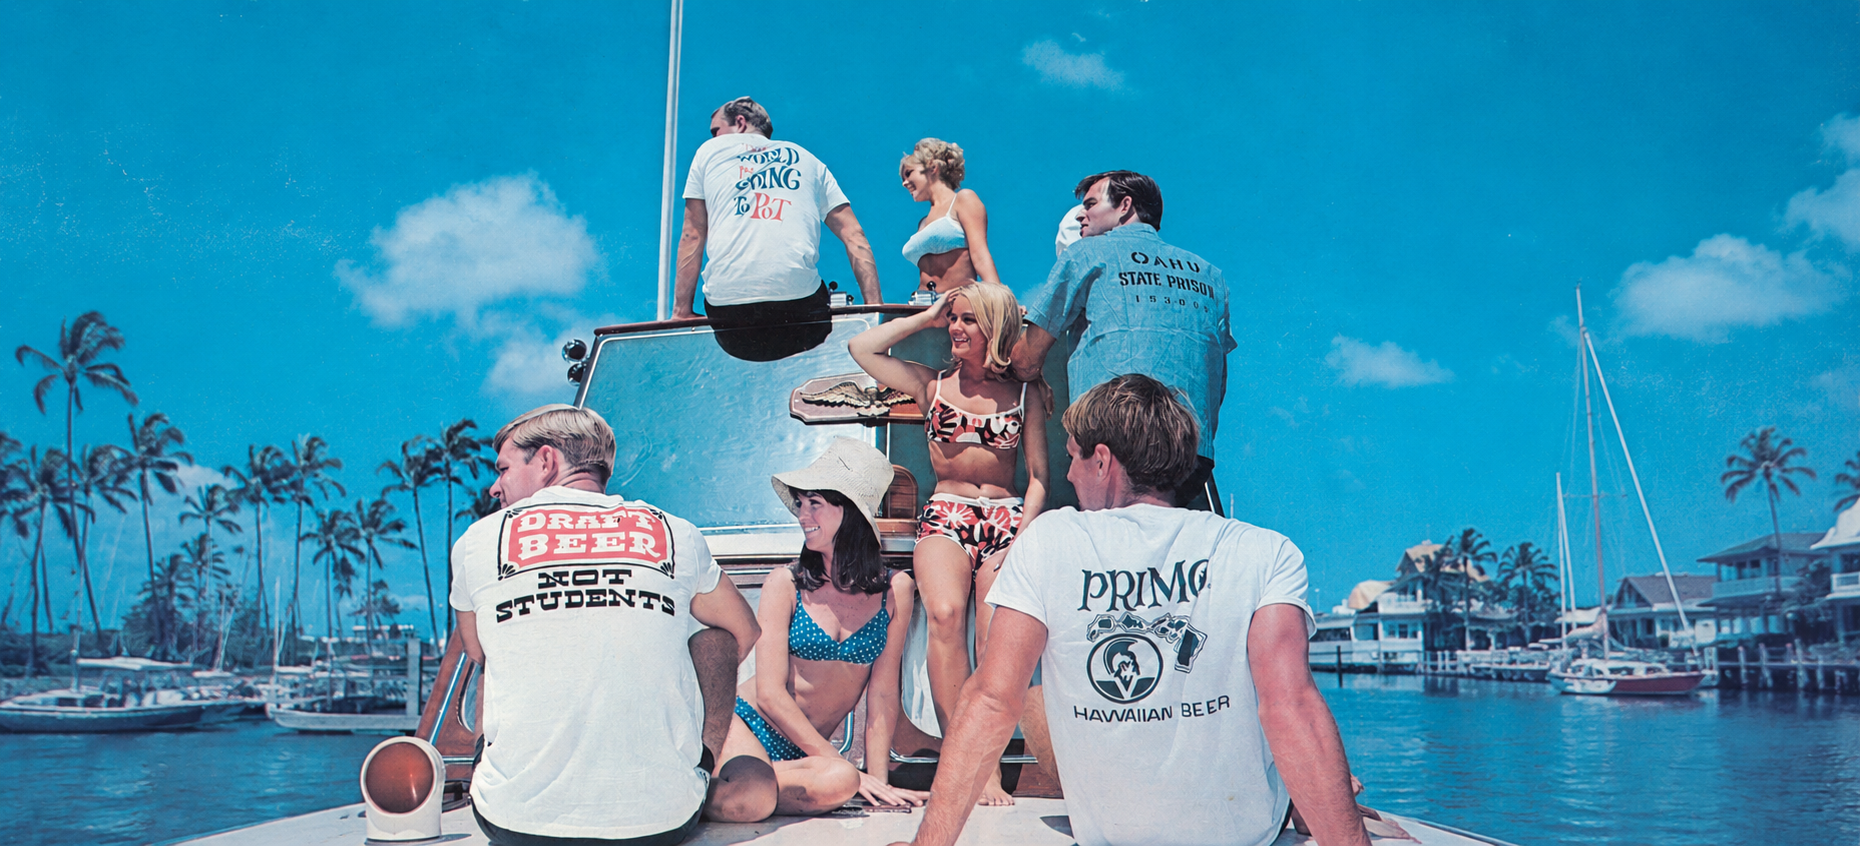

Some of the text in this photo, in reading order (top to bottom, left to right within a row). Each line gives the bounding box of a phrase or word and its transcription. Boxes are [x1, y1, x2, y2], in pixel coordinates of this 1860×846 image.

[735, 165, 802, 190] GOING
[1130, 251, 1201, 273] OAHU
[1118, 271, 1215, 300] STATE PRISON
[517, 511, 656, 533] DRAFT
[517, 531, 661, 561] BEER
[537, 568, 632, 590] NOT
[1077, 558, 1209, 612] PRIMO
[495, 588, 676, 623] STUDENTS
[1073, 694, 1231, 723] HAWAIIAN BEER
